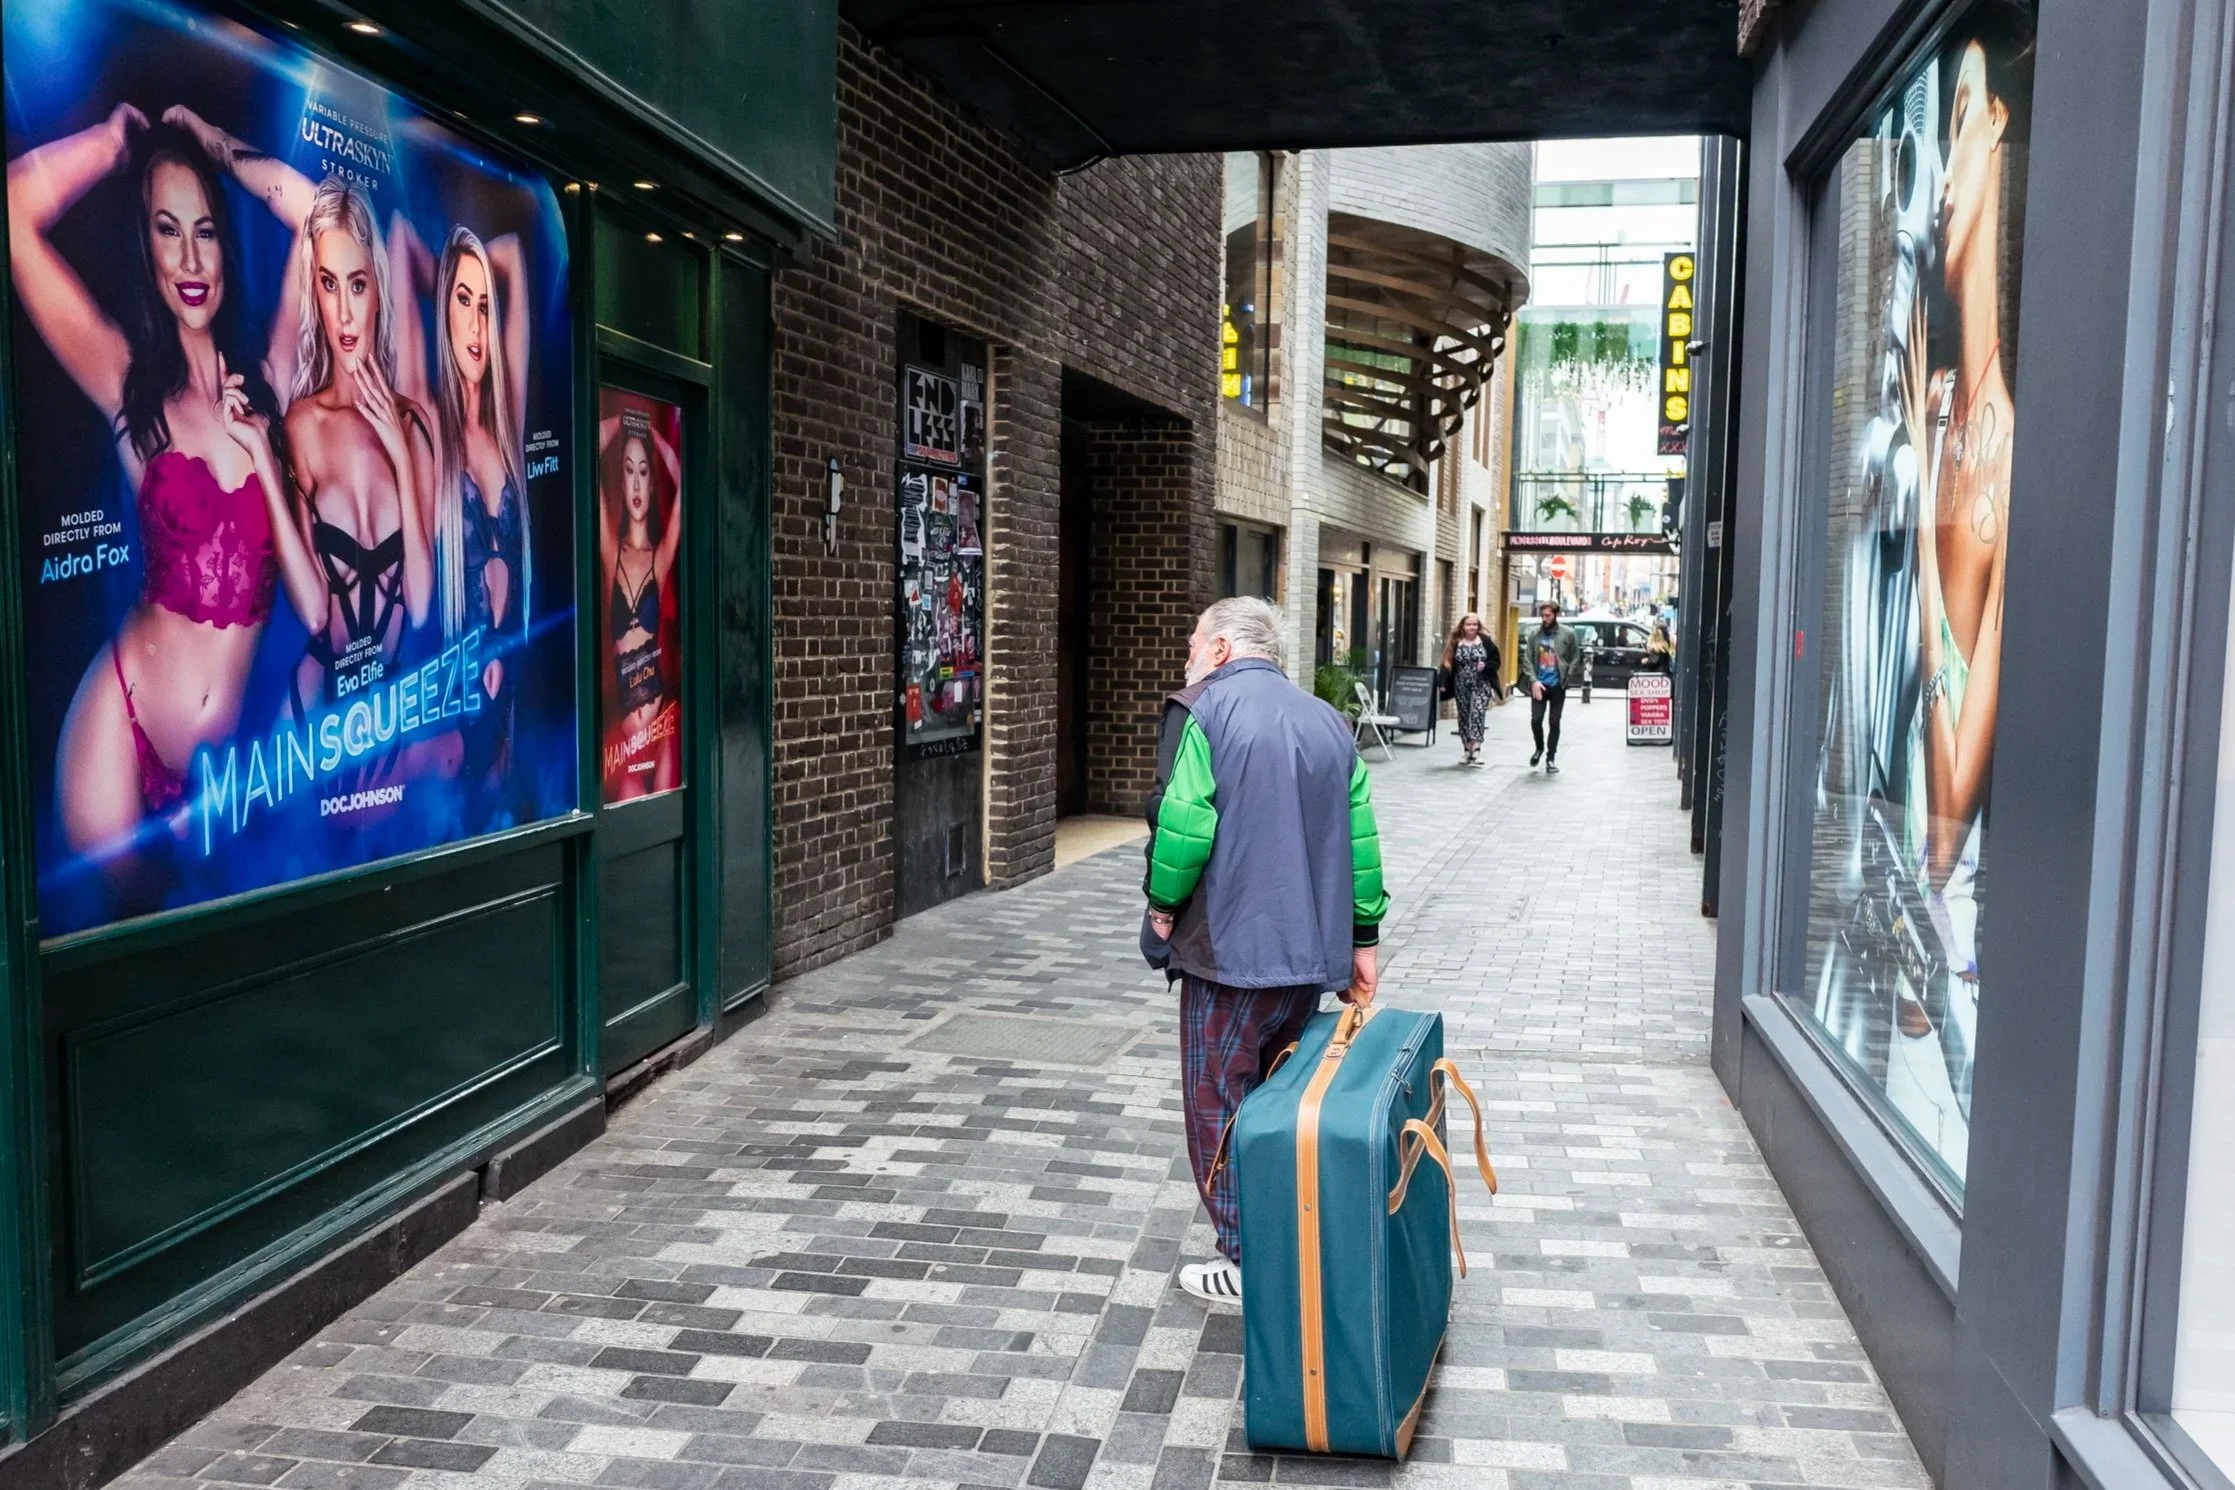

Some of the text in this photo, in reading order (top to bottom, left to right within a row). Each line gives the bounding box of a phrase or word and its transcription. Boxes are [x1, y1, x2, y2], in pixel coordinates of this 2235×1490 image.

[306, 100, 388, 144] VARIABLE PRESSURE
[302, 117, 392, 175] ULTRASKYN
[322, 159, 378, 190] STROKER
[1665, 256, 1694, 421] CABINS
[61, 509, 104, 527] MOLDED
[43, 522, 121, 546] DIRECTLY FROM
[41, 543, 129, 584] Aidra Fox
[335, 643, 383, 670] DIRECTLY FROM
[345, 635, 372, 653] MOLDED
[361, 660, 384, 686] Elfie
[1630, 679, 1669, 688] MOOD
[1631, 727, 1667, 735] OPEN
